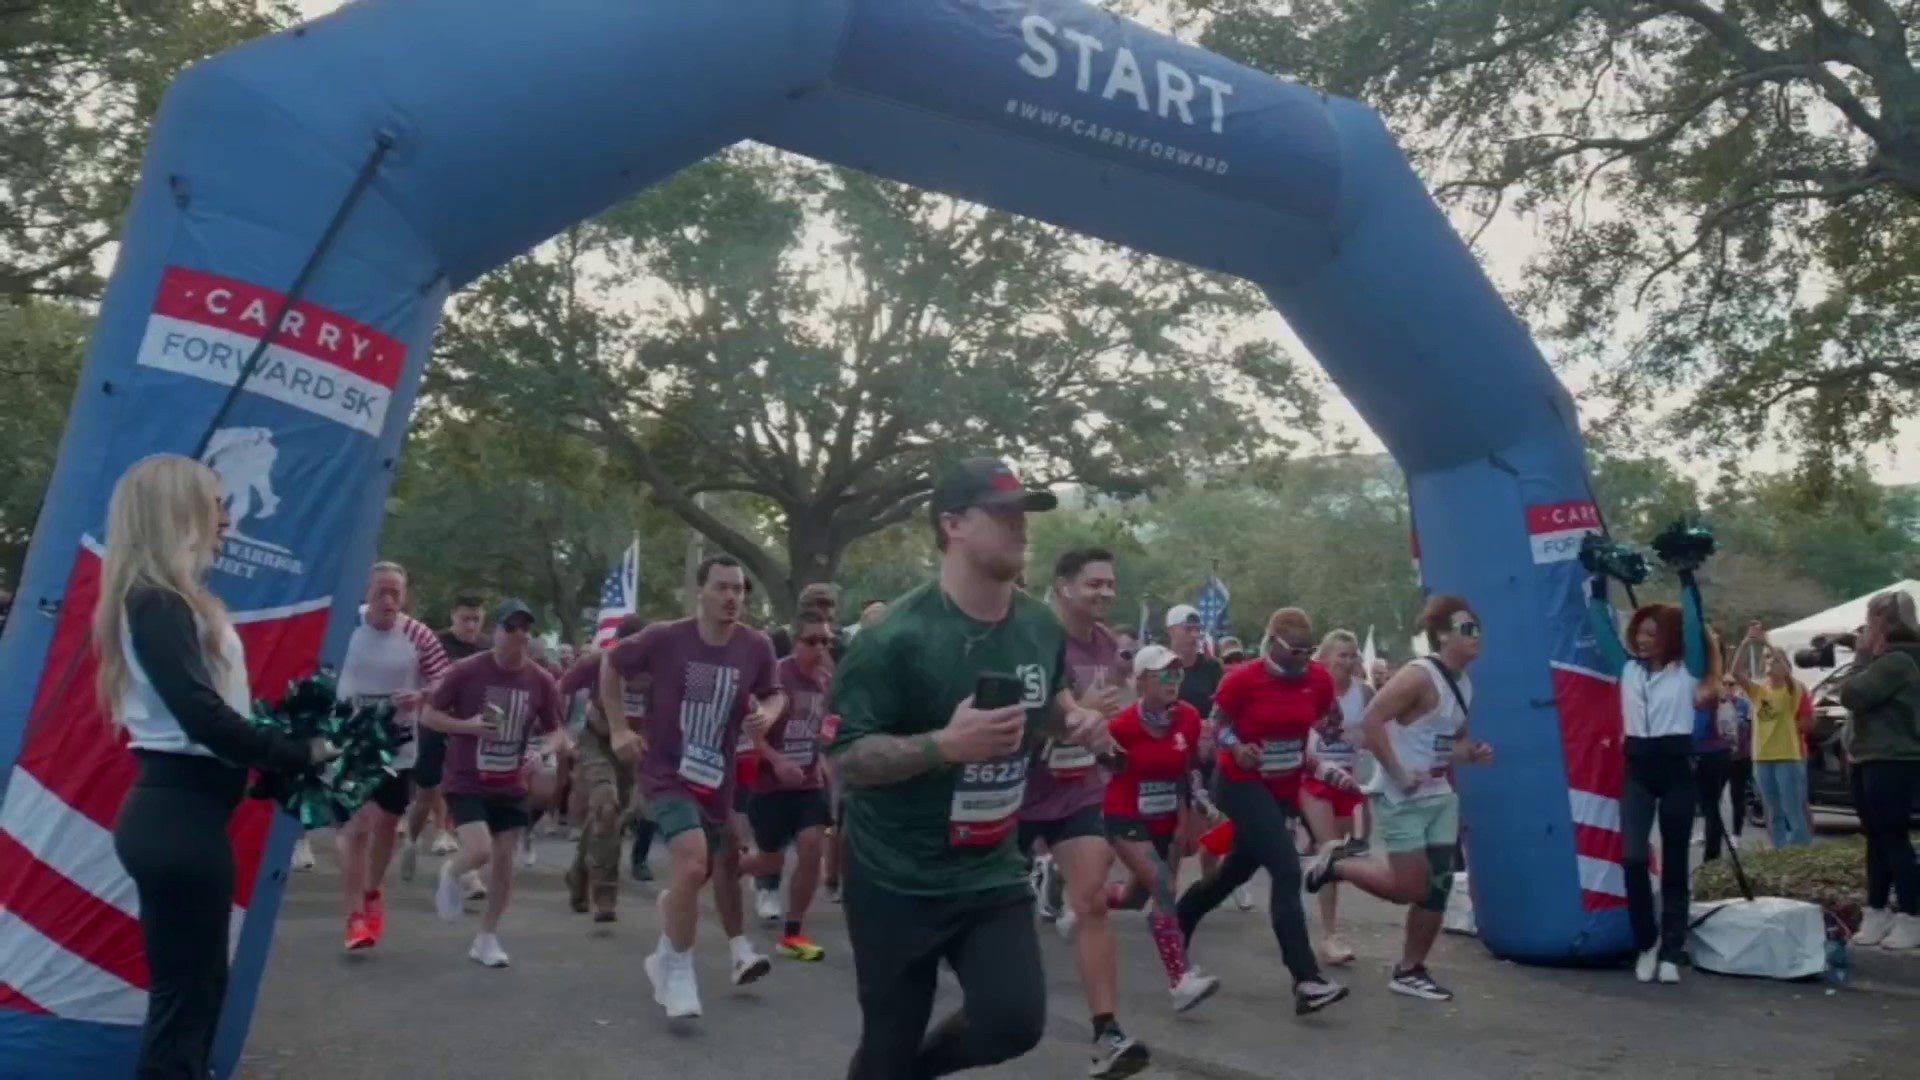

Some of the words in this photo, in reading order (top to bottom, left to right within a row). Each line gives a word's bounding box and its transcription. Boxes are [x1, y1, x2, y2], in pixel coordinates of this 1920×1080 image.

[1017, 14, 1234, 134] START
[1005, 98, 1229, 176] #WWPCARRYFORWARD
[205, 288, 371, 361] CARRY
[161, 331, 336, 400] FORWARD
[341, 386, 378, 419] 5K
[227, 543, 303, 575] WARRIOR
